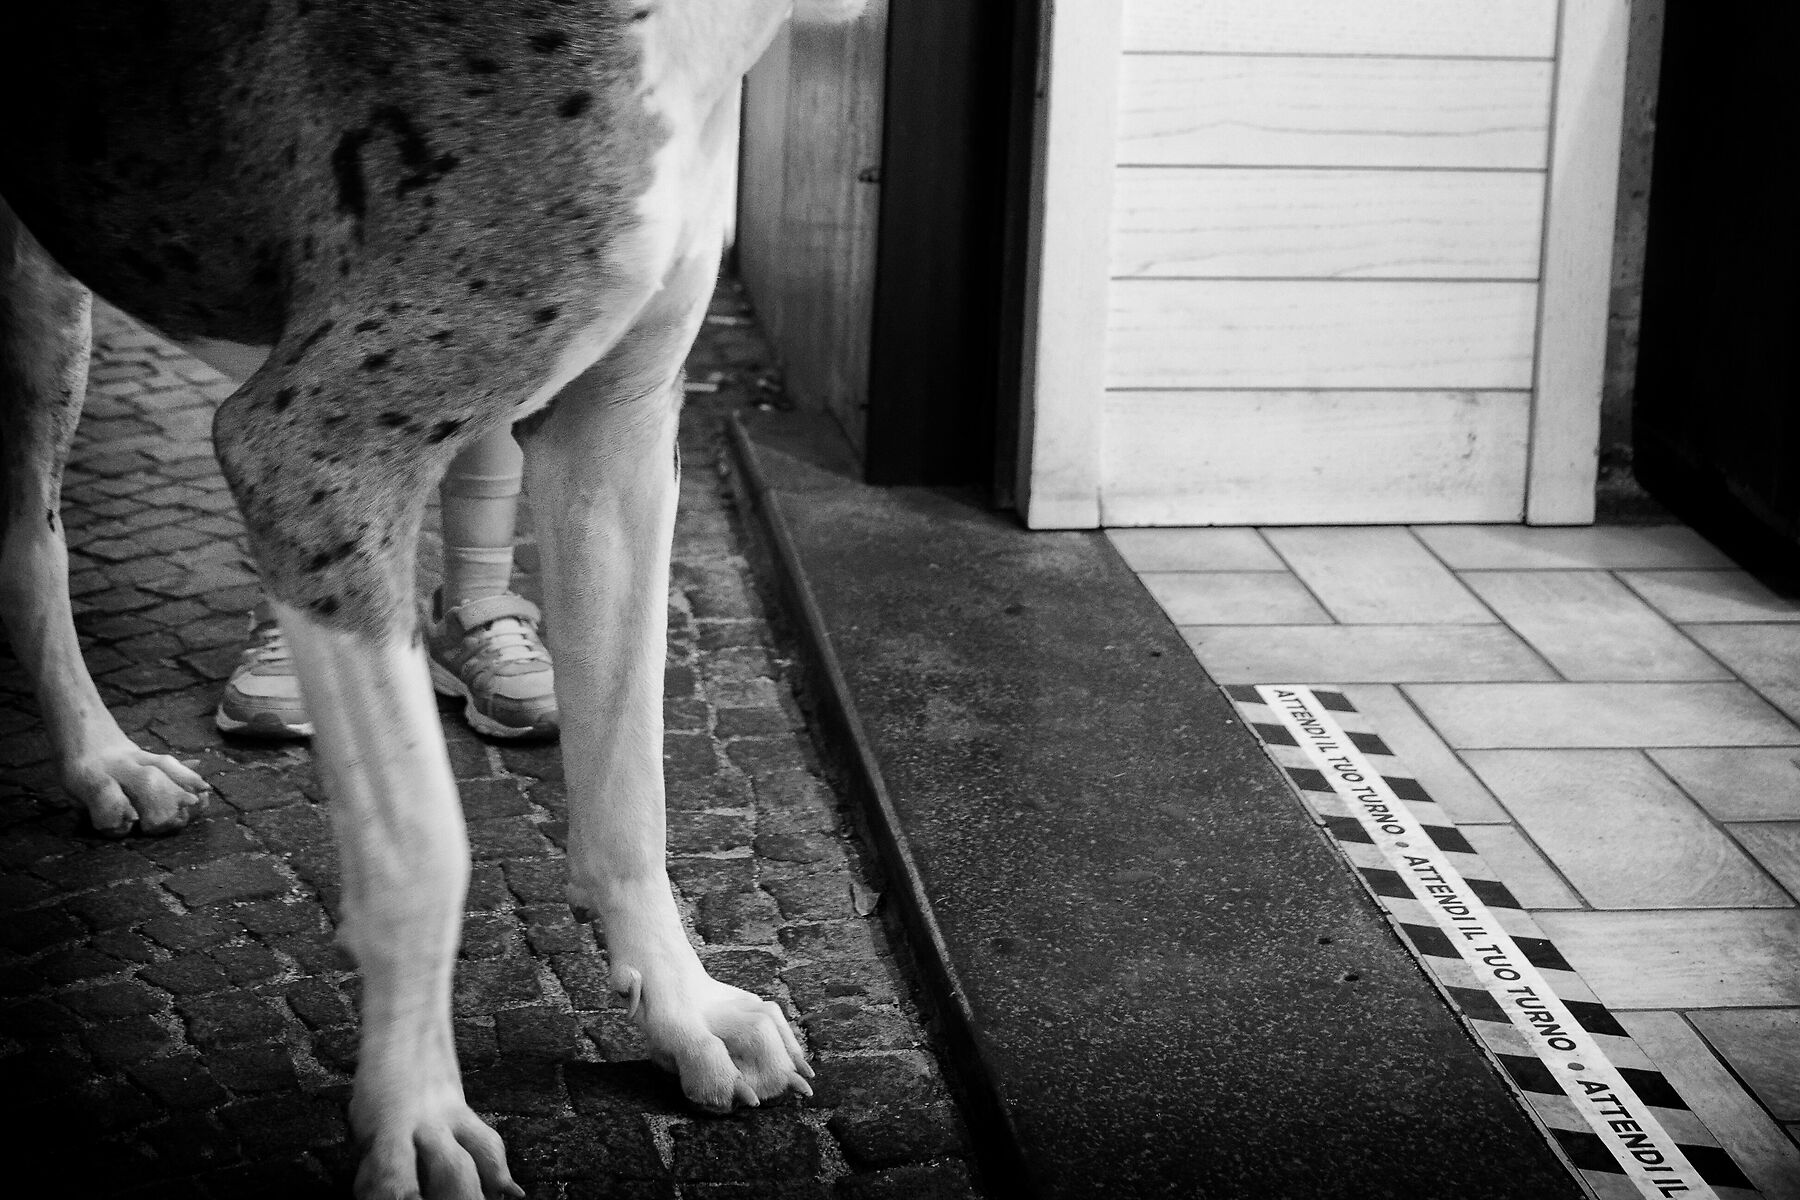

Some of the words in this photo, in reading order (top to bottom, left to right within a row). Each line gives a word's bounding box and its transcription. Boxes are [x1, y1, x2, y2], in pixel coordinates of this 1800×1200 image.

[1273, 689, 1331, 739] ATTENDI
[1316, 742, 1340, 752] IL
[1328, 755, 1364, 782] TUO
[1351, 785, 1405, 835] TURNO
[1403, 854, 1476, 923] ATTENDI
[1458, 926, 1487, 940] IL
[1475, 944, 1521, 981] TUO
[1507, 986, 1577, 1051] TURNO
[1576, 1079, 1674, 1171] ATTENDI
[1652, 1179, 1690, 1199] IL
